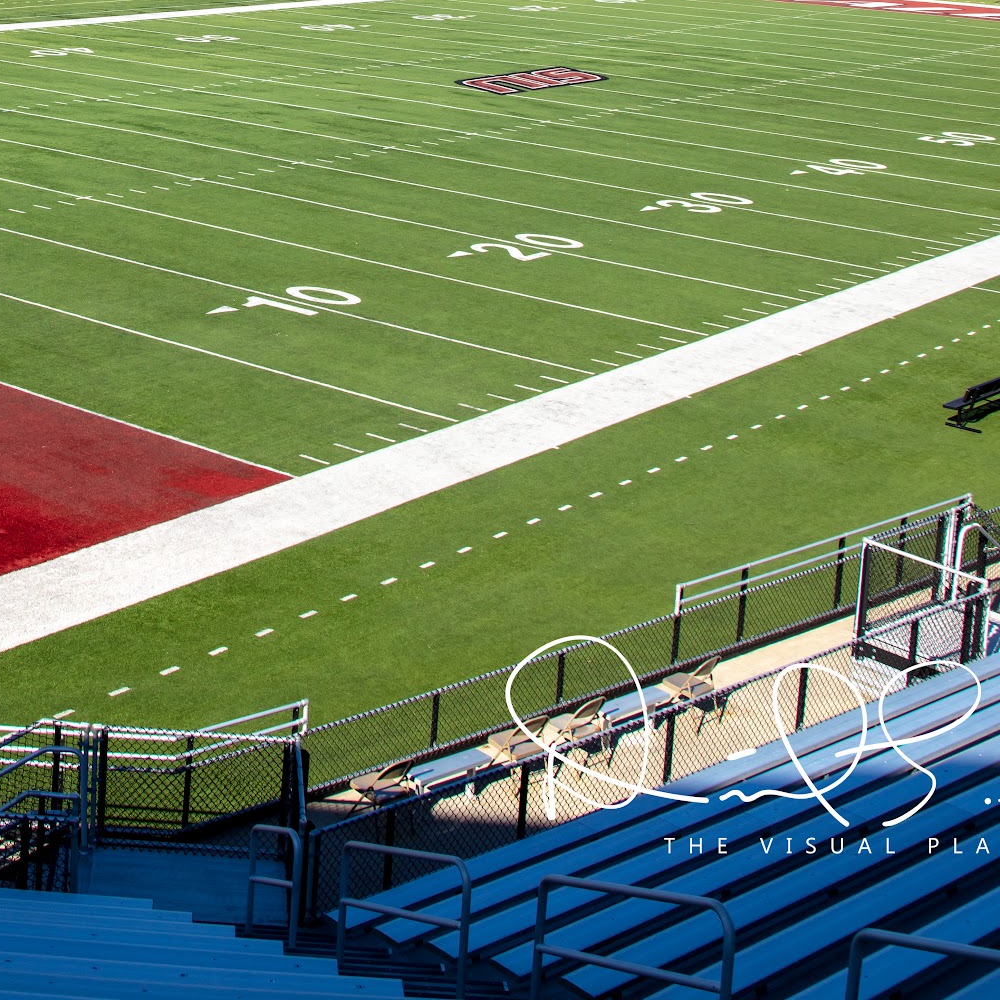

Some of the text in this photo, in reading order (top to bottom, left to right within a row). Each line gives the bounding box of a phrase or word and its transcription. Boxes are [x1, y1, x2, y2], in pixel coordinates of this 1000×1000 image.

[917, 131, 997, 147] 50
[806, 158, 888, 176] 40
[656, 192, 753, 214] 30
[470, 233, 584, 262] 20
[242, 285, 362, 316] 10
